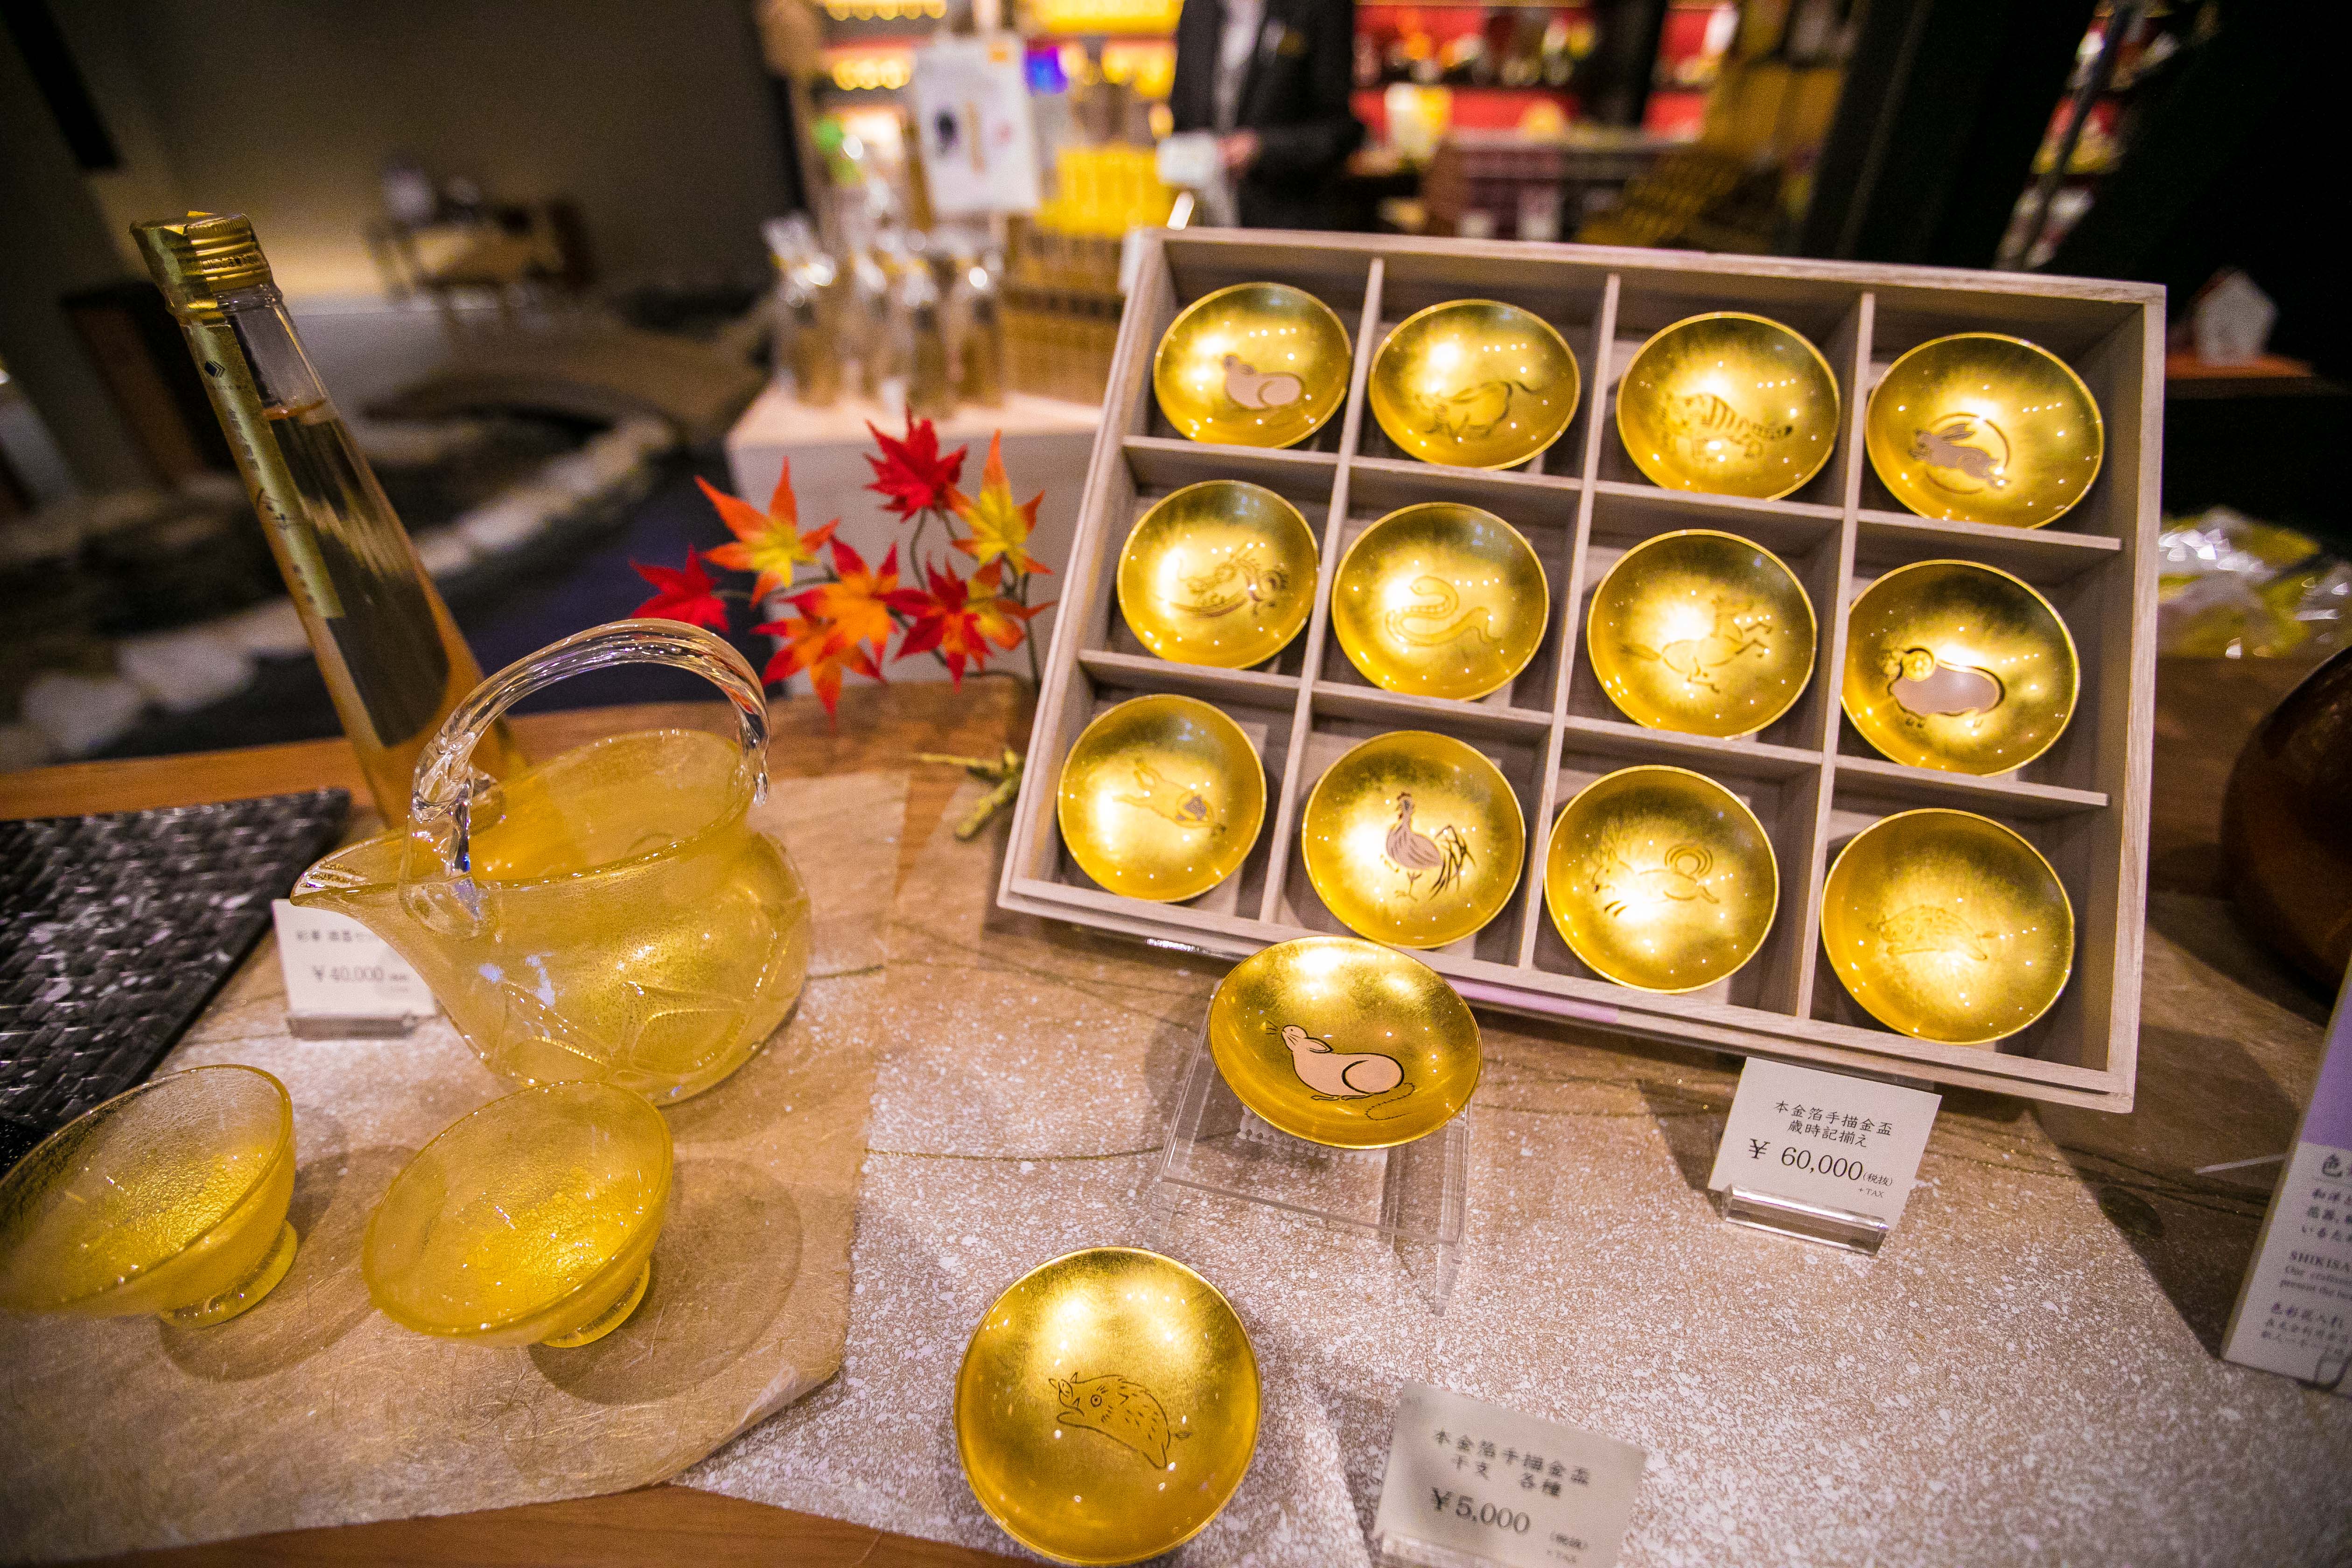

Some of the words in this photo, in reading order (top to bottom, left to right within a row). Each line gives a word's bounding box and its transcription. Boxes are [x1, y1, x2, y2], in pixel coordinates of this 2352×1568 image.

[1774, 1100, 1893, 1136] 本金箔手描金盃
[1787, 1120, 1868, 1148] 歳時記揃え
[1781, 1147, 1863, 1181] 60,000
